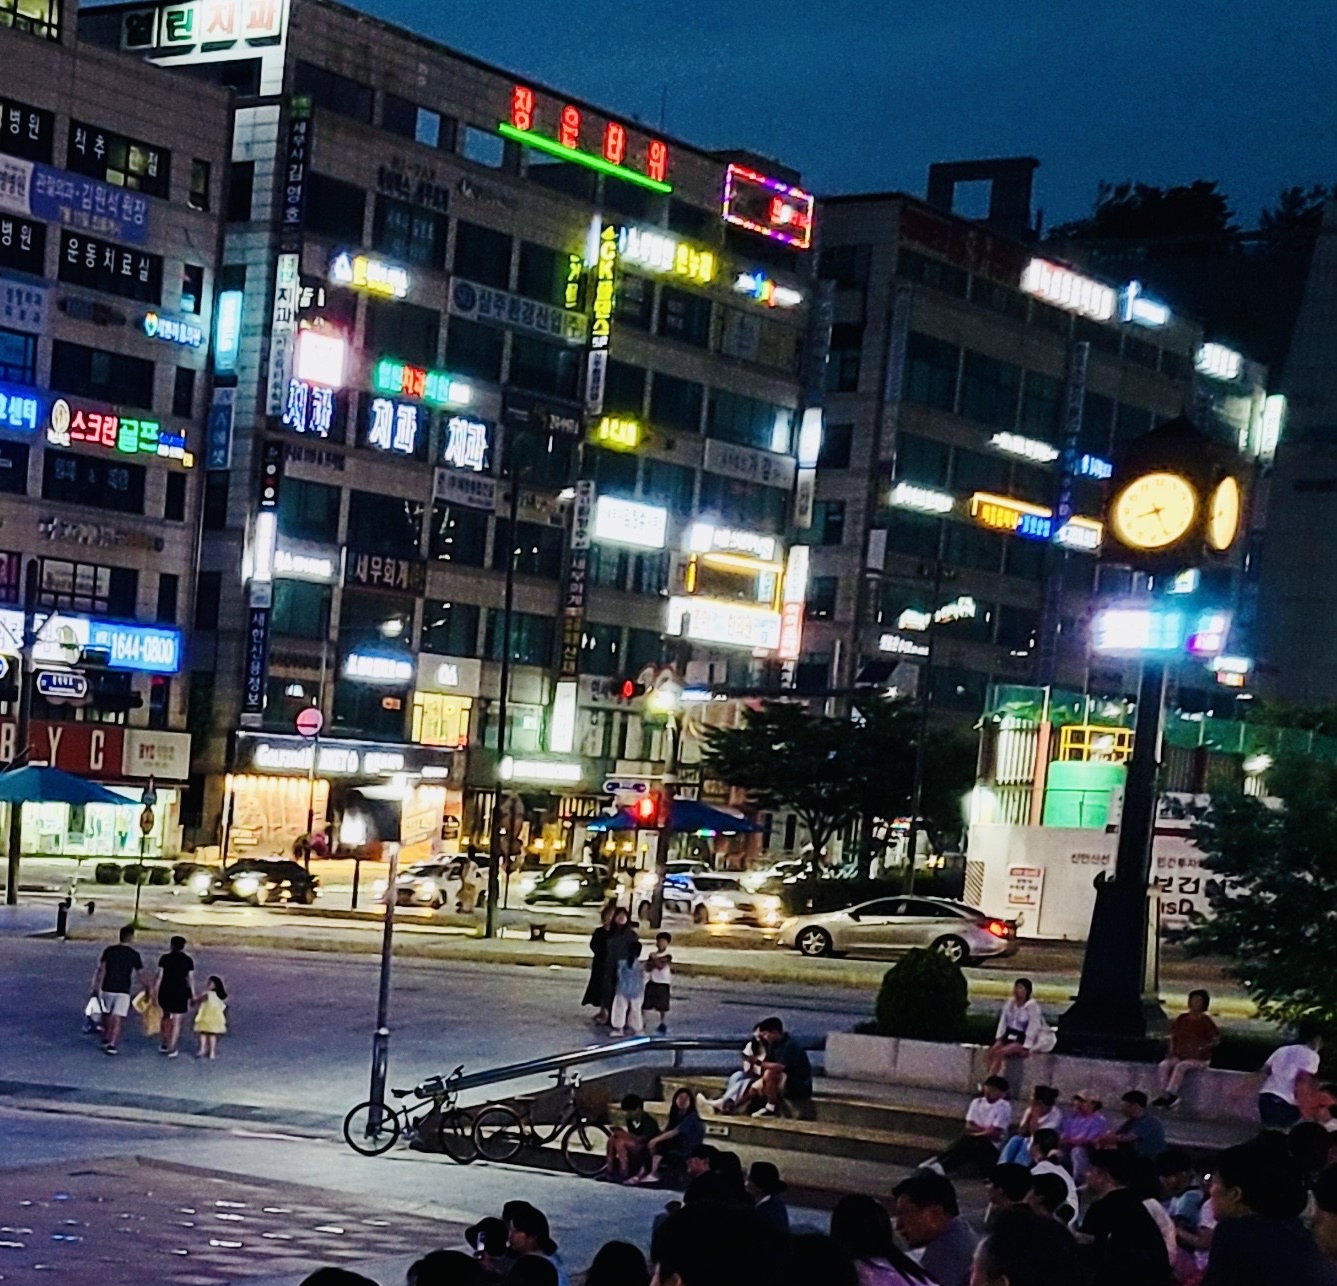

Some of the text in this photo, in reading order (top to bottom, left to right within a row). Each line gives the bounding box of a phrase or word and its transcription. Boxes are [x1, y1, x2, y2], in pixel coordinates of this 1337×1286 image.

[67, 238, 151, 283] 운동치료실
[70, 409, 159, 454] 스크린골프
[355, 554, 409, 591] 세무회계
[111, 630, 174, 665] 1644-0800
[0, 722, 106, 772] BYC
